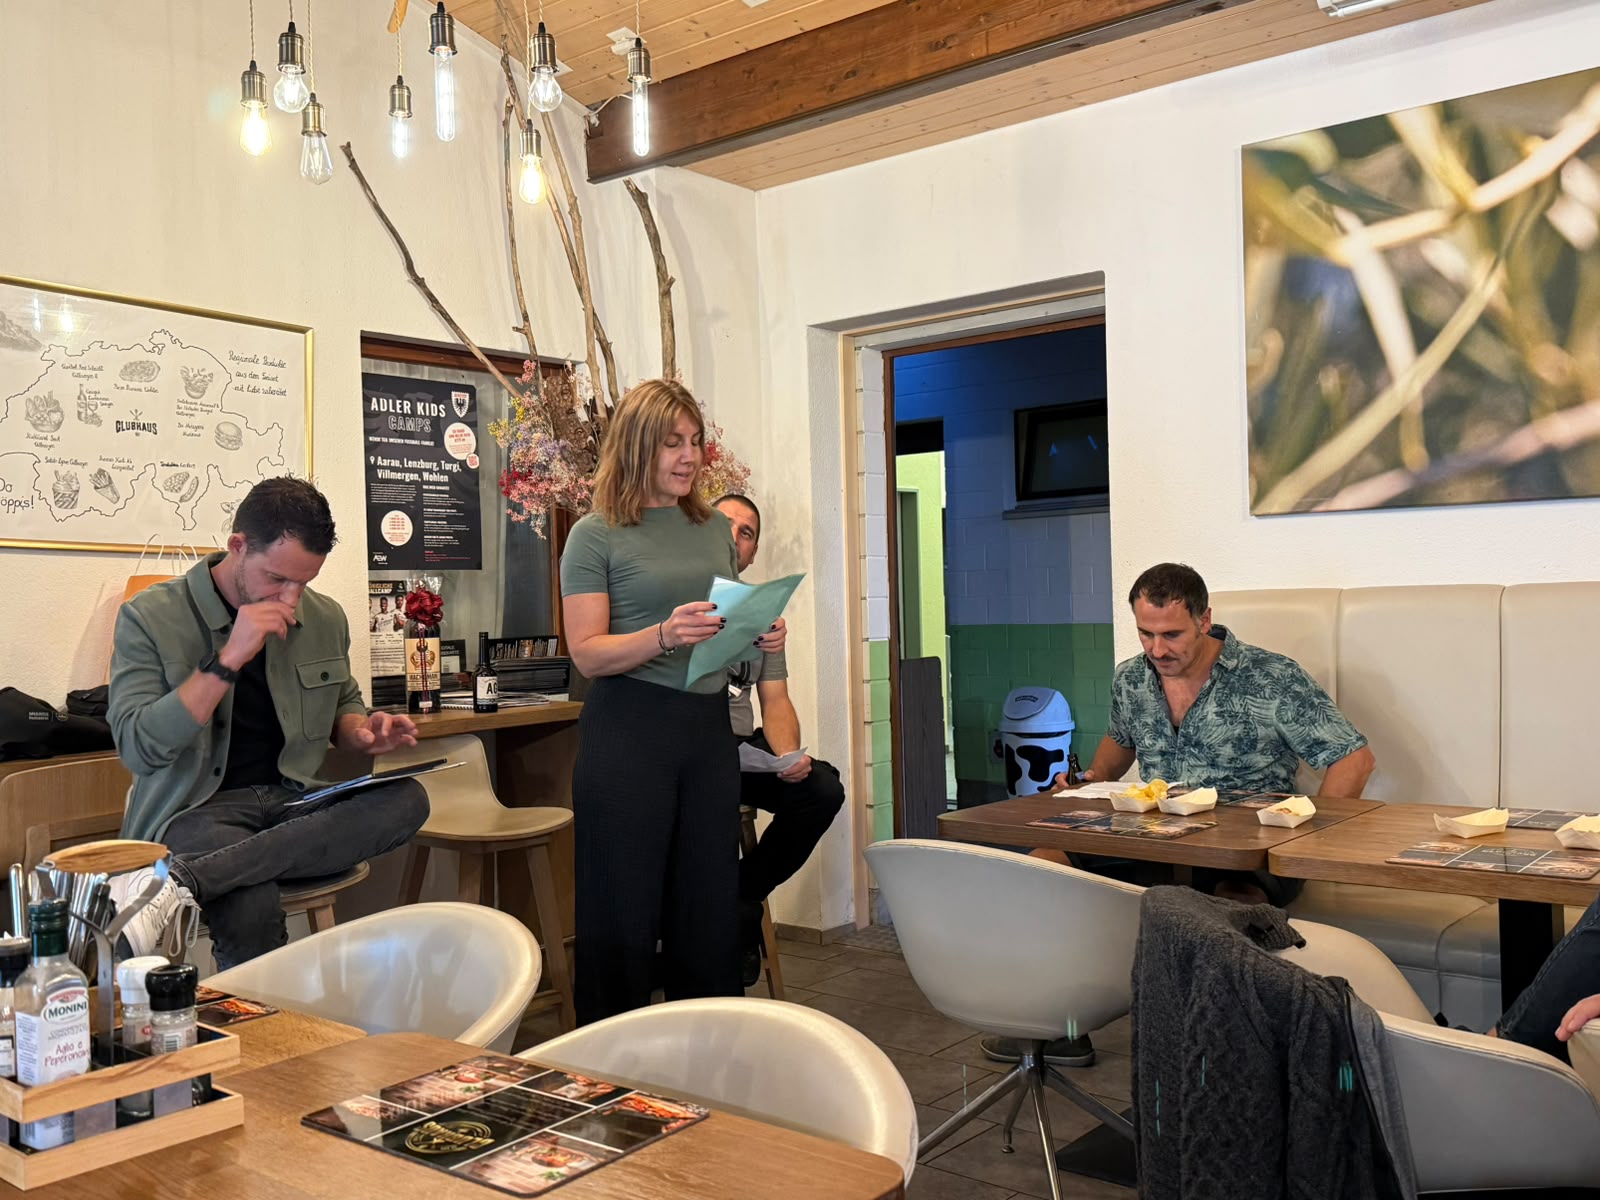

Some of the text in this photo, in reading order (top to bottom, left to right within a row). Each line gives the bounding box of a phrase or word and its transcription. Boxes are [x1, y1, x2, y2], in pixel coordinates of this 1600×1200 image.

[229, 350, 260, 365] Regionale
[235, 371, 247, 379] aus
[370, 397, 446, 418] ADLER KIDS
[115, 420, 158, 436] CLUBHAUS
[388, 415, 432, 433] CAMPS
[377, 456, 403, 469] Aarau,
[403, 458, 440, 472] Lenzburg,
[377, 469, 449, 483] Villmergen, Wohlen
[48, 1001, 87, 1019] MONINI
